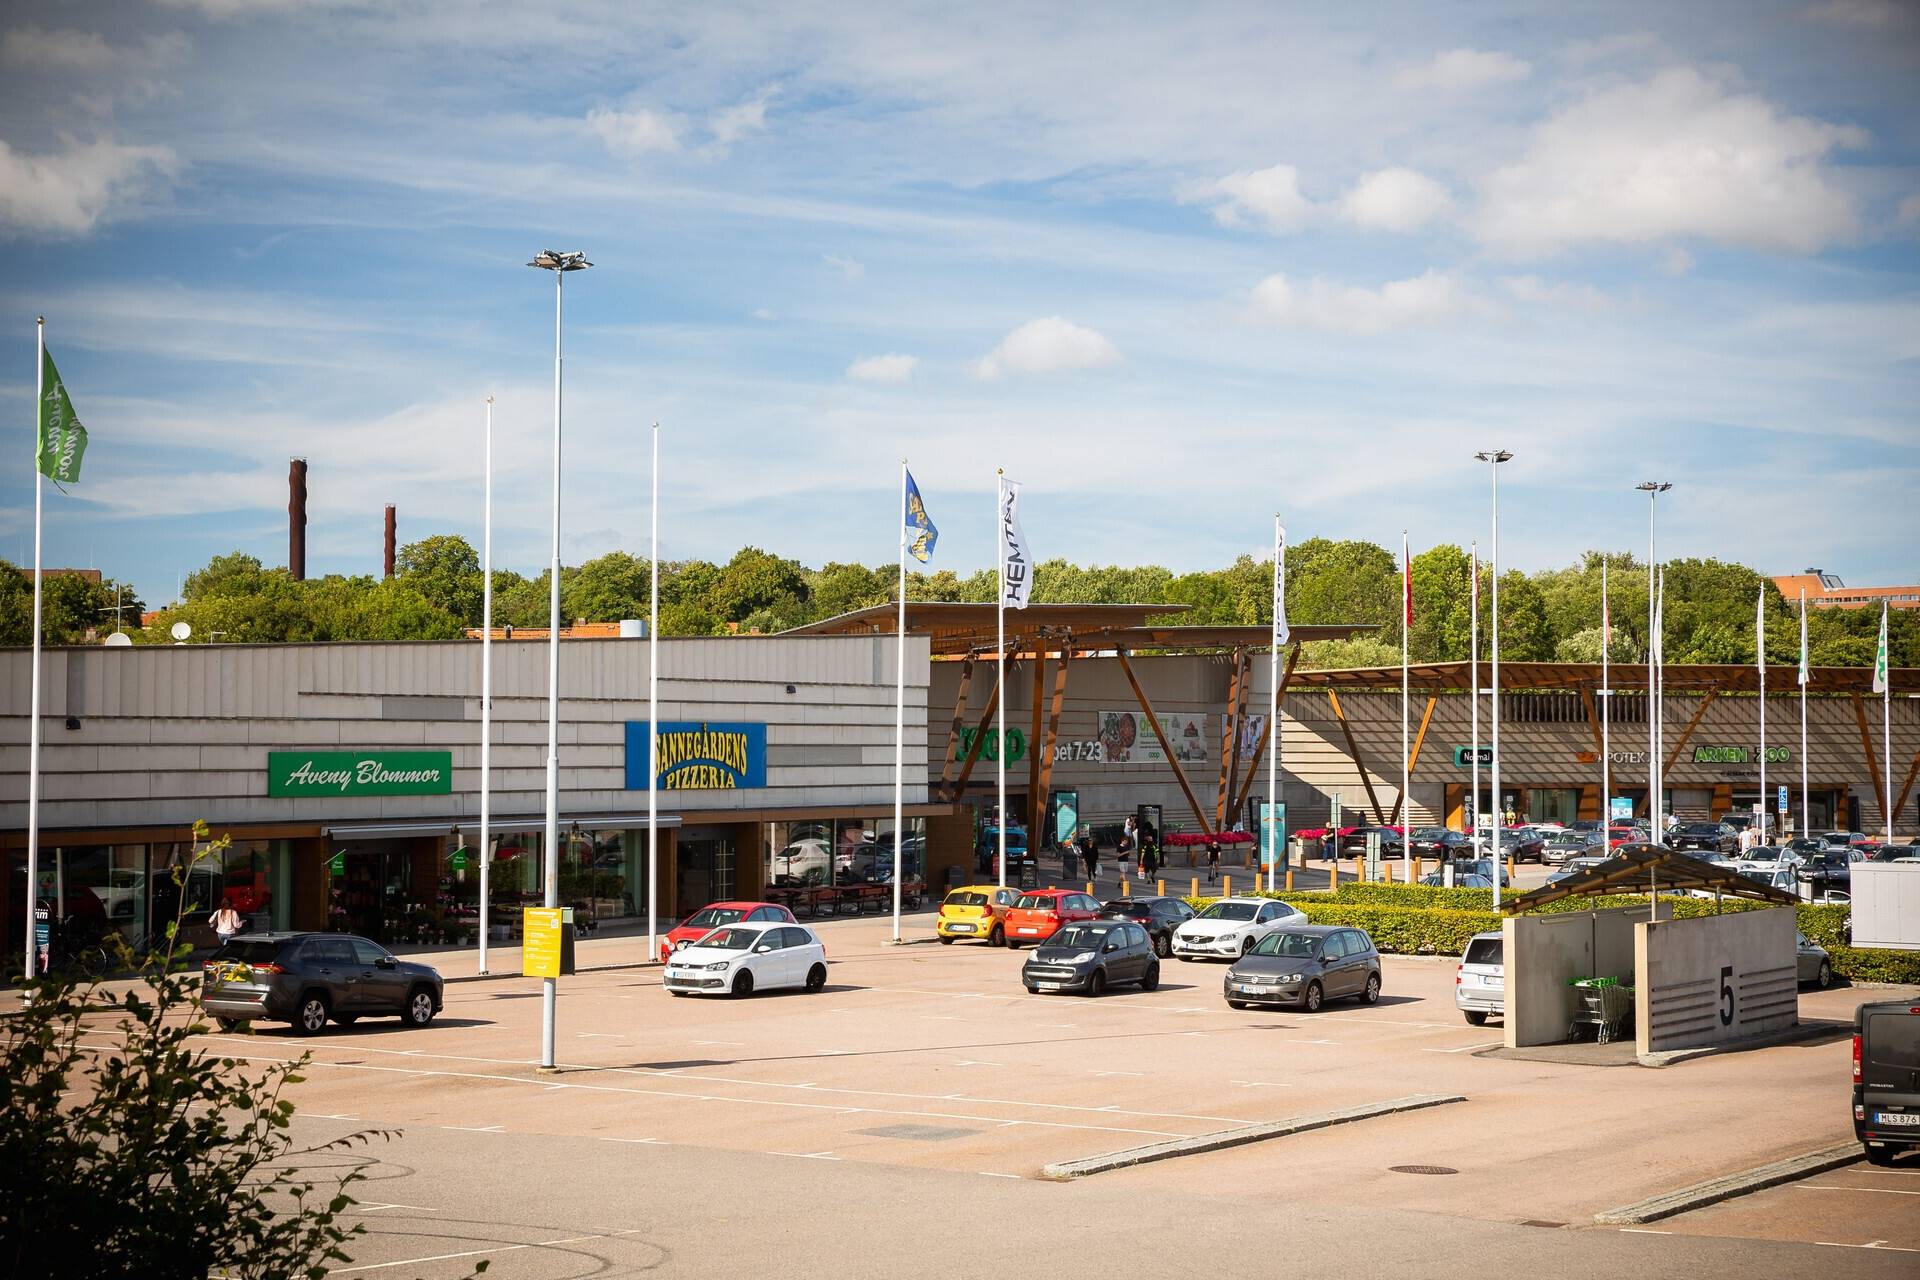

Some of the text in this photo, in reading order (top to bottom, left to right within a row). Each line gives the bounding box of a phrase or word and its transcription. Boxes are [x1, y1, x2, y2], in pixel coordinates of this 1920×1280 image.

[1073, 742, 1102, 761] 7-23
[1464, 752, 1490, 761] Nomal
[1694, 746, 1748, 763] ARKEN
[285, 760, 440, 791] Aveny Blommor
[665, 765, 736, 789] PIZZERIA
[1720, 966, 1734, 1026] 5
[1881, 1114, 1917, 1124] MLS 876
